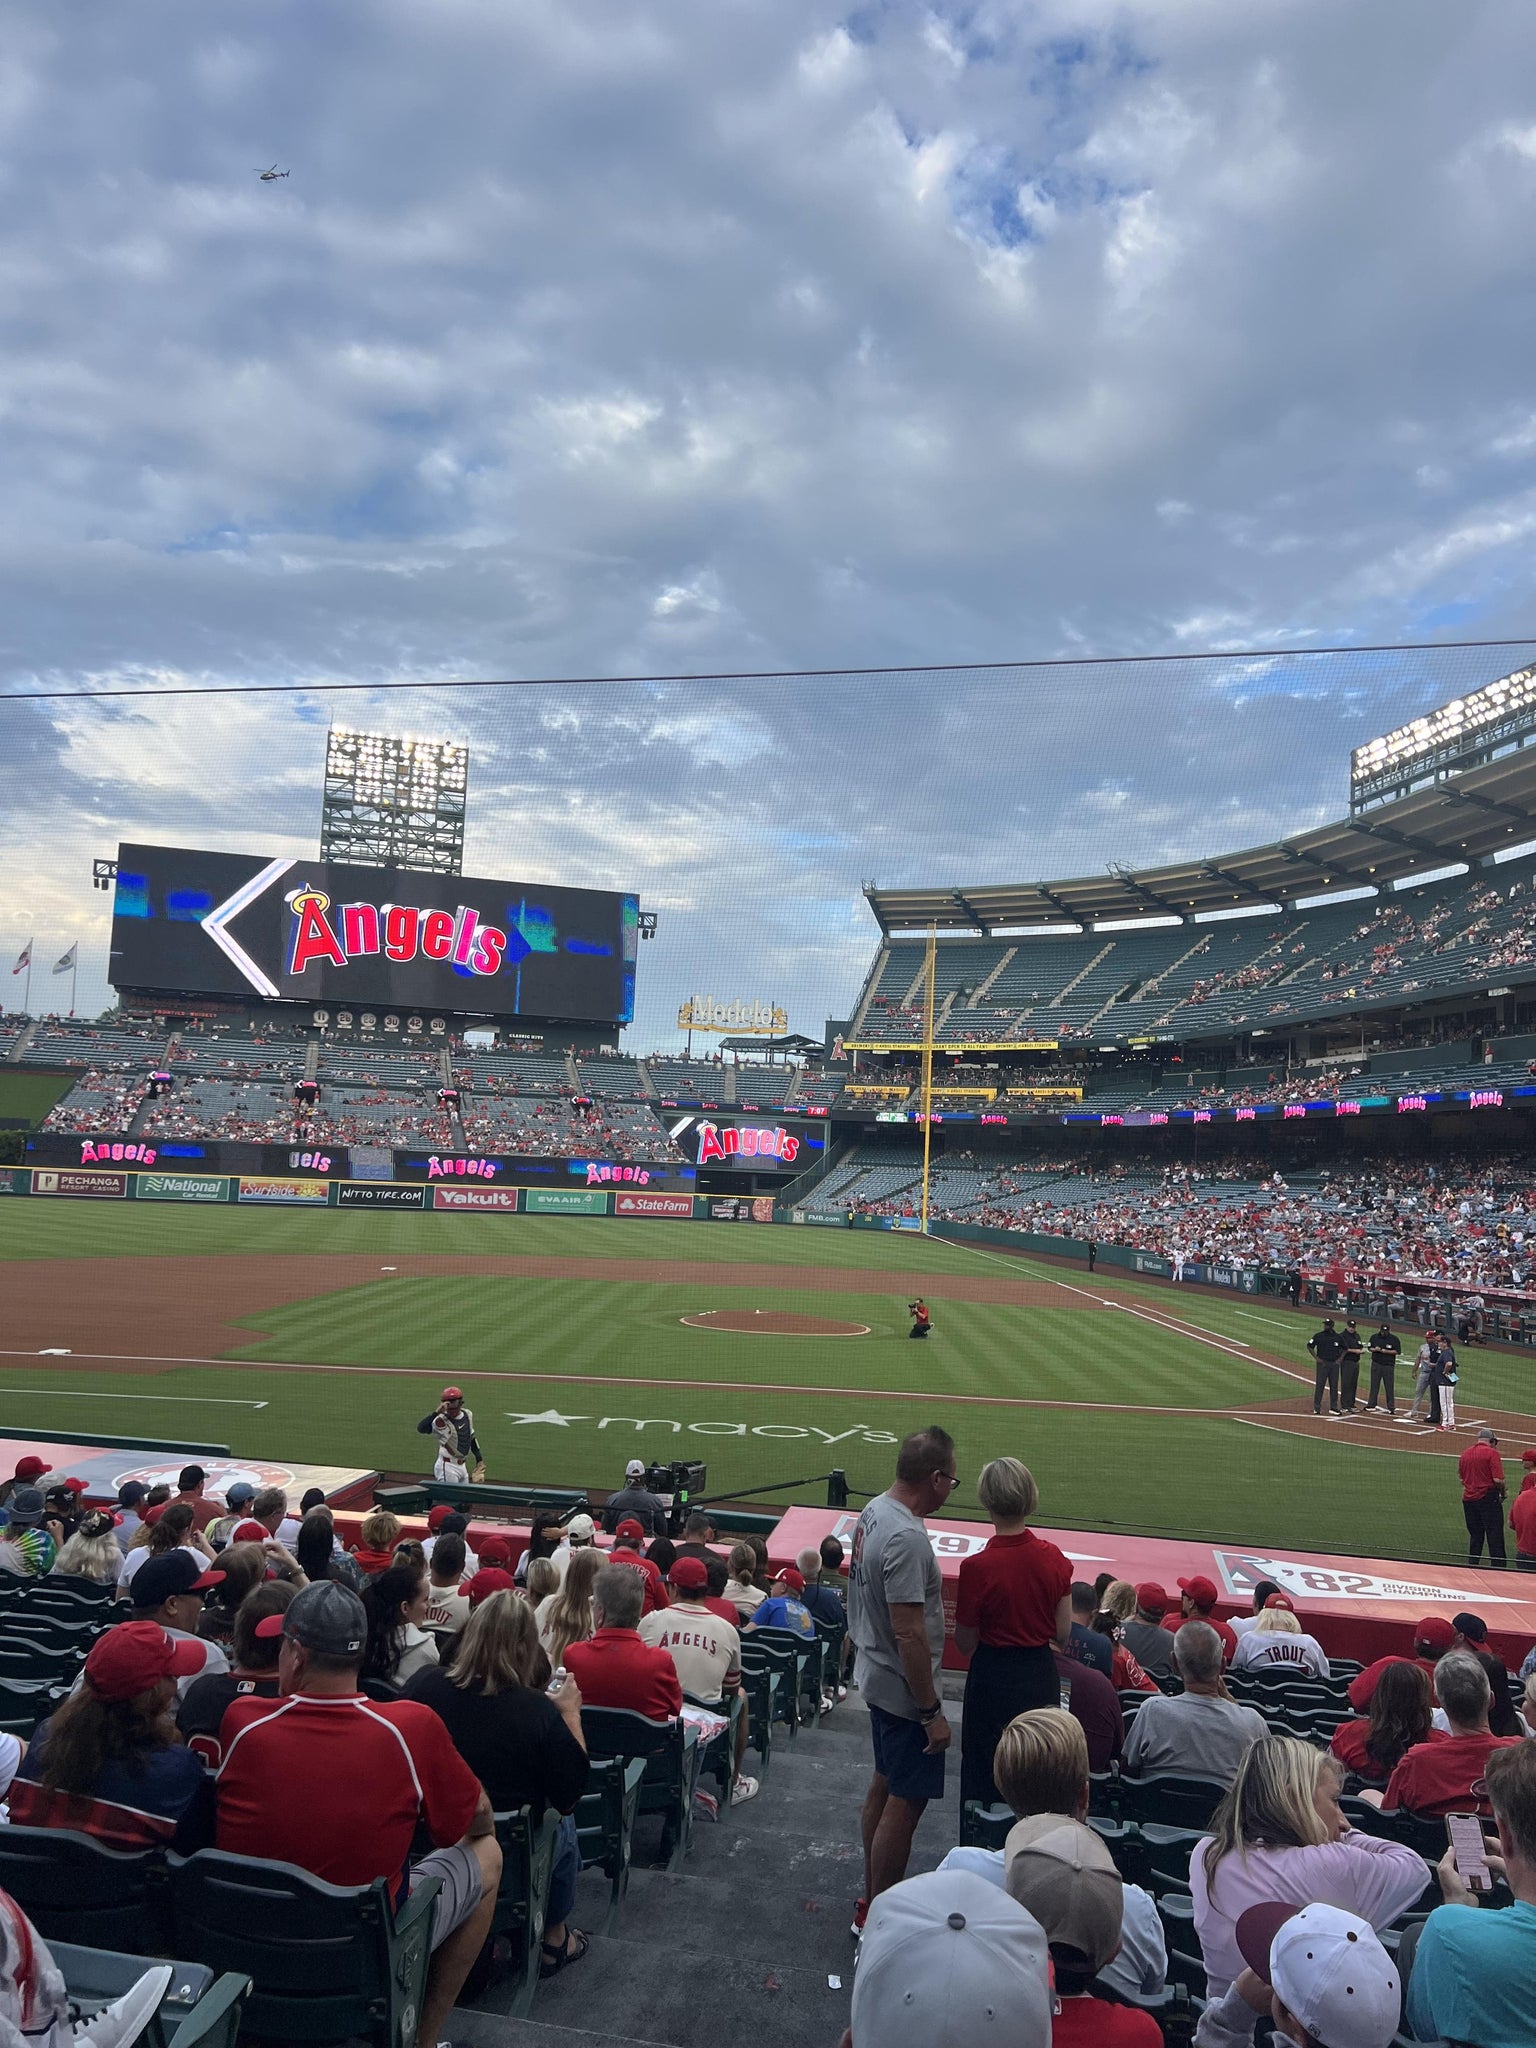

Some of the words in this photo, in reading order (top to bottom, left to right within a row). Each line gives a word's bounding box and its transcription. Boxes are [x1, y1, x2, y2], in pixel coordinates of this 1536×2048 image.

[288, 884, 506, 975] Angels
[316, 1012, 325, 1021] 11
[409, 1019, 421, 1029] 42
[1398, 1096, 1426, 1113] Angels
[1470, 1091, 1503, 1109] Angels
[811, 1107, 828, 1116] 7:07
[1336, 1101, 1361, 1116] Angels
[914, 1112, 943, 1124] Anels
[981, 1113, 1008, 1126] Angels
[696, 1119, 800, 1164] Angels
[81, 1140, 157, 1165] Angels
[289, 1151, 331, 1172] gels
[428, 1156, 496, 1179] Angels
[61, 1176, 120, 1186] PECHANGA
[586, 1163, 650, 1185] Angels
[162, 1178, 221, 1193] National
[244, 1183, 296, 1197] Surfside
[341, 1188, 373, 1199] NITTO
[375, 1191, 421, 1201] TIRE.COM
[440, 1190, 512, 1206] Yakult
[808, 1214, 841, 1223] FMB.com
[1282, 1568, 1381, 1596] '82
[1382, 1583, 1441, 1594] DIVISION
[1383, 1588, 1467, 1601] CHAMPIONS
[659, 1630, 718, 1656] ANGELS
[1264, 1645, 1306, 1663] TROUT
